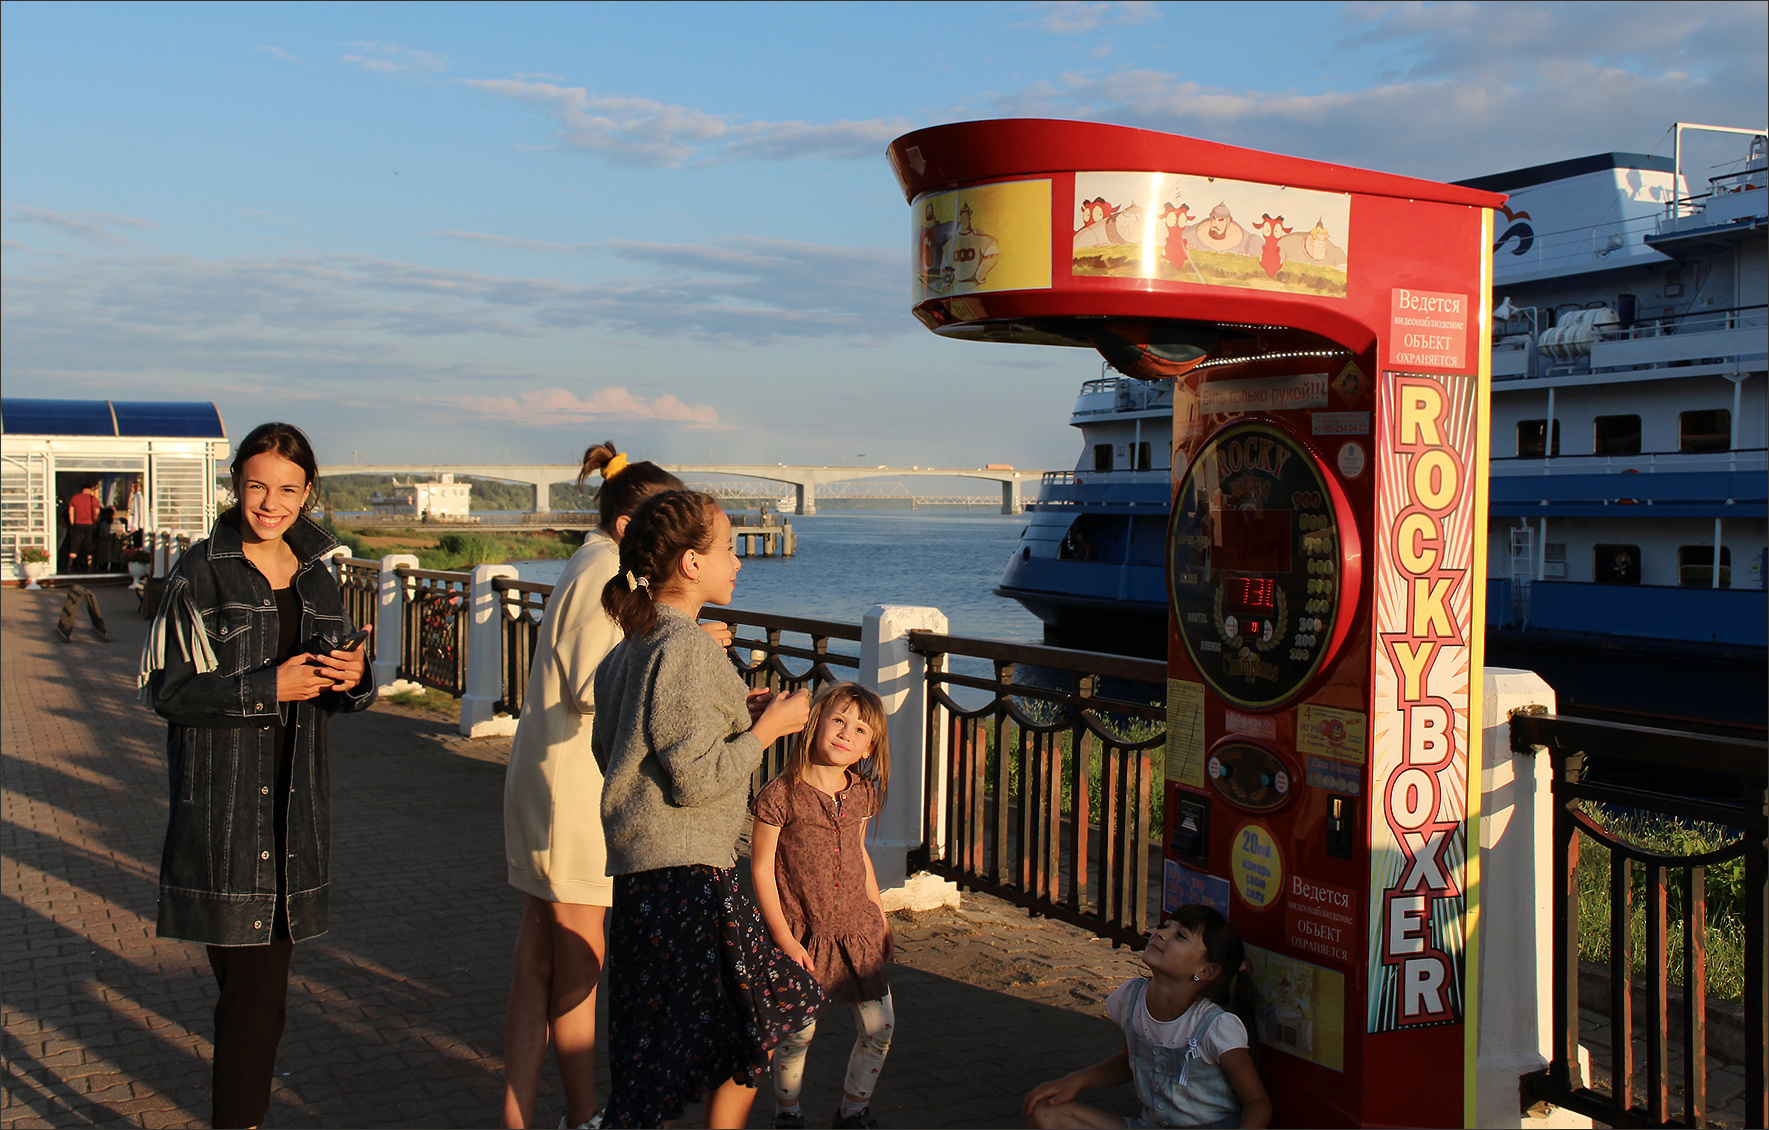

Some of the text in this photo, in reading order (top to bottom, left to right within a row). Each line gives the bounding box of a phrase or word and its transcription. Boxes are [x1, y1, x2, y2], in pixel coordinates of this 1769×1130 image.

[1399, 289, 1461, 313] Ведется
[1394, 316, 1464, 330] видеонаблюдение
[1404, 333, 1452, 350] ОБЪЕКТ
[1396, 352, 1458, 367] ОХРАНЯЕТСЯ
[1230, 389, 1268, 404] только
[1271, 382, 1326, 406] рукой!!!
[1213, 436, 1292, 482] ROCKY
[1303, 706, 1312, 721] 4
[1241, 858, 1272, 878] измерь
[1246, 873, 1267, 890] свою
[1292, 875, 1349, 908] Ведется
[1246, 887, 1265, 904] силу
[1288, 900, 1353, 925] видеонаблюдение
[1297, 919, 1342, 943] ОБЪЕКТ
[1291, 935, 1348, 961] ОХРАНЯЕТСЯ
